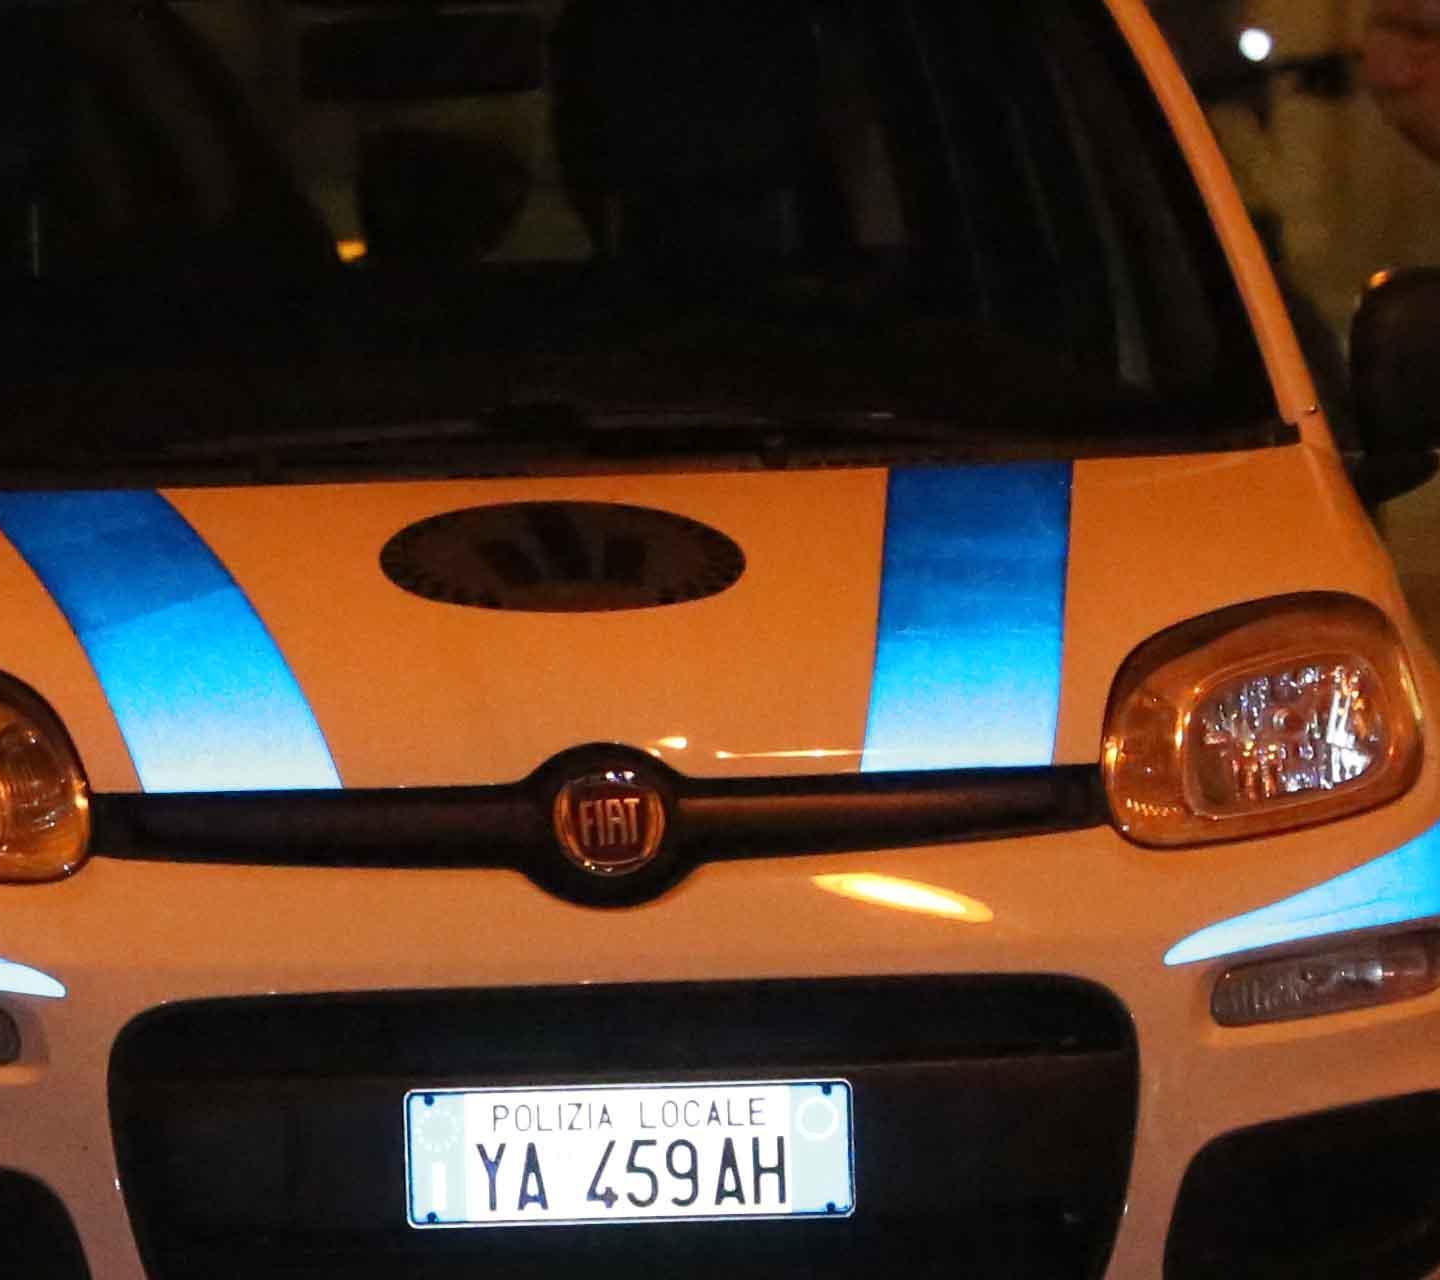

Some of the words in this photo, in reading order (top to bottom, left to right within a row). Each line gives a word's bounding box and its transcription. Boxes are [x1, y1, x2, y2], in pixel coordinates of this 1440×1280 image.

[579, 798, 640, 847] FIAT
[493, 1101, 614, 1133] POLIZIA
[639, 1098, 767, 1129] LOCALE
[476, 1141, 549, 1212] YA
